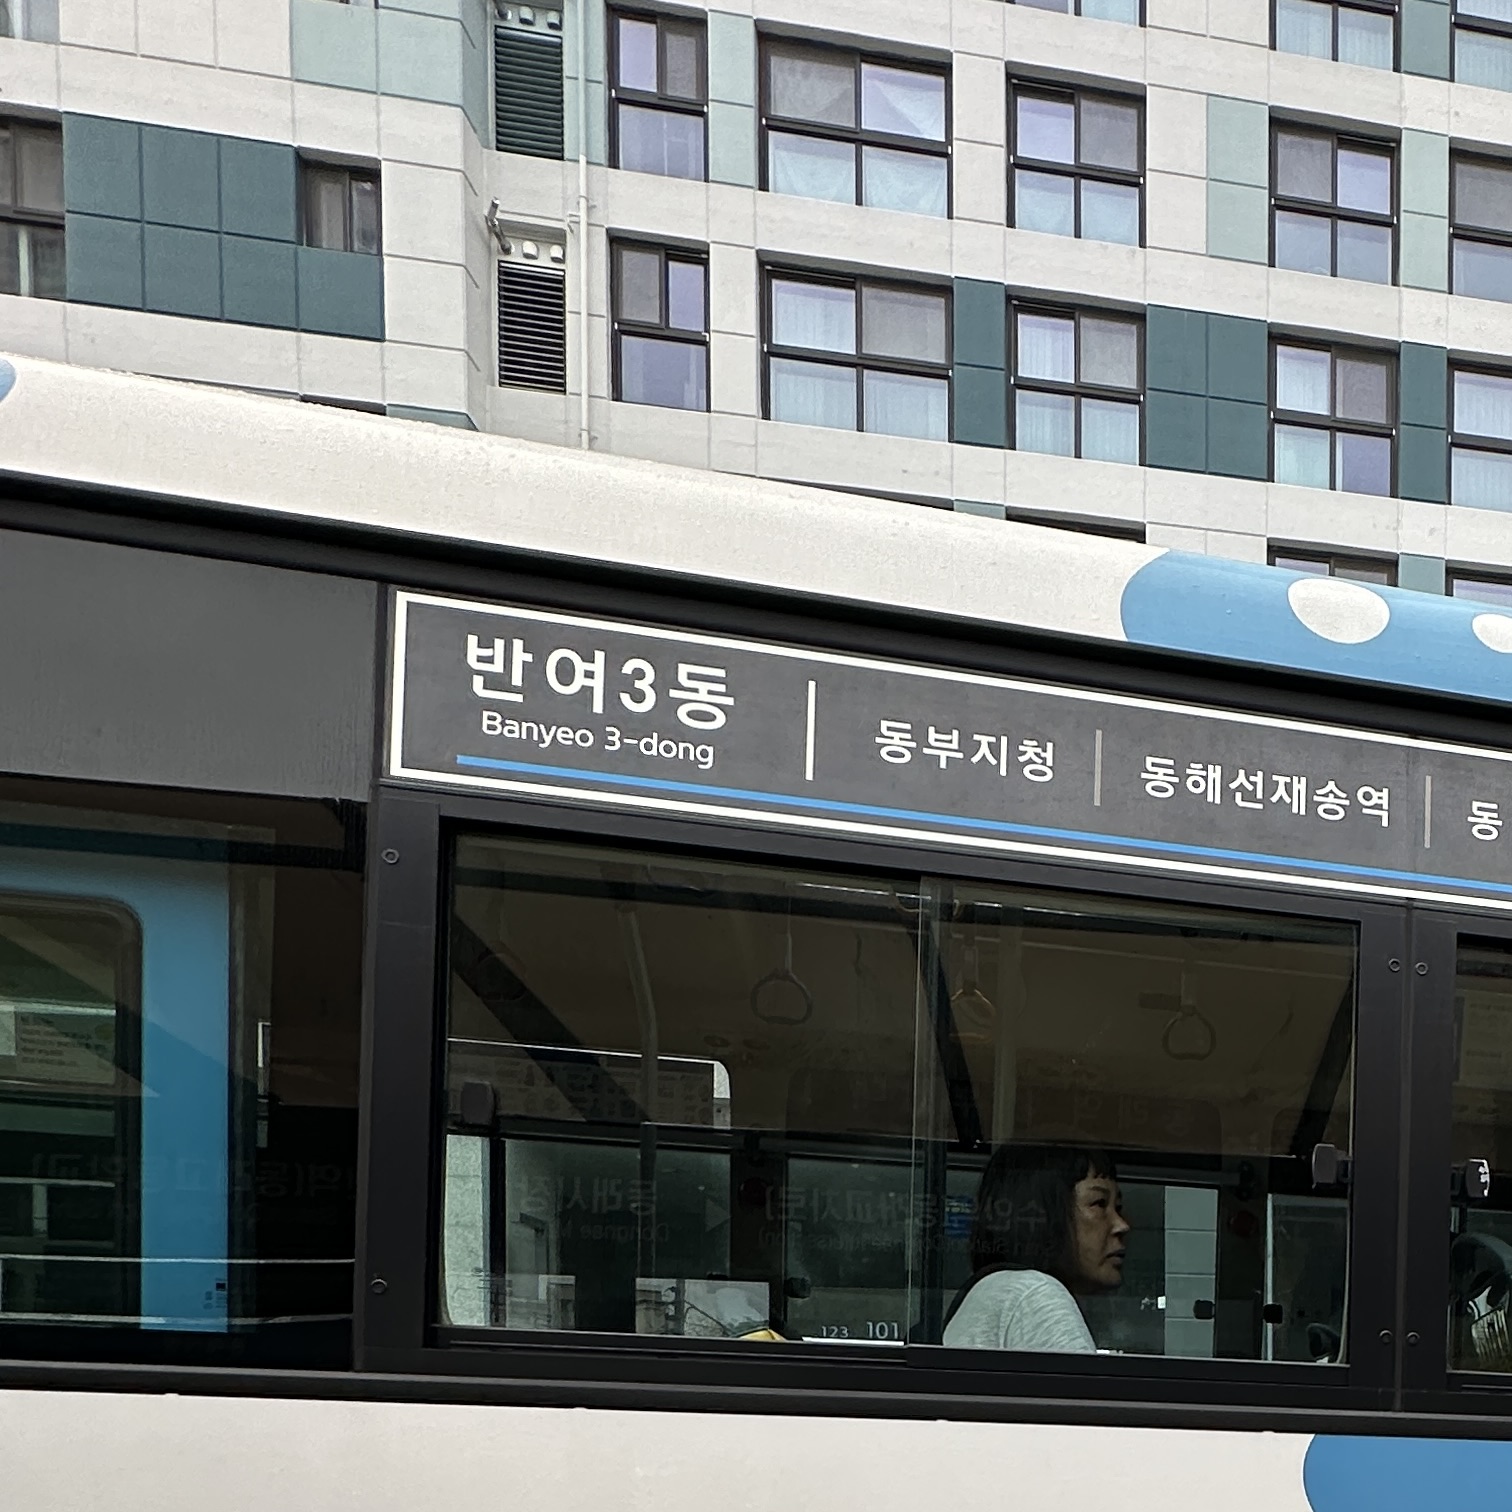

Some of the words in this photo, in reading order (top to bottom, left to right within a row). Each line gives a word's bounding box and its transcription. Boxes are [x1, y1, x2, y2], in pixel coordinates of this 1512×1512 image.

[464, 632, 736, 731] 반여3동
[481, 710, 594, 748] Banyeo
[603, 725, 715, 769] 3-dong
[873, 716, 1056, 783] 동부지청
[1140, 755, 1391, 828] 동해선재송역
[821, 1325, 849, 1338] 123
[866, 1321, 899, 1340] 101
